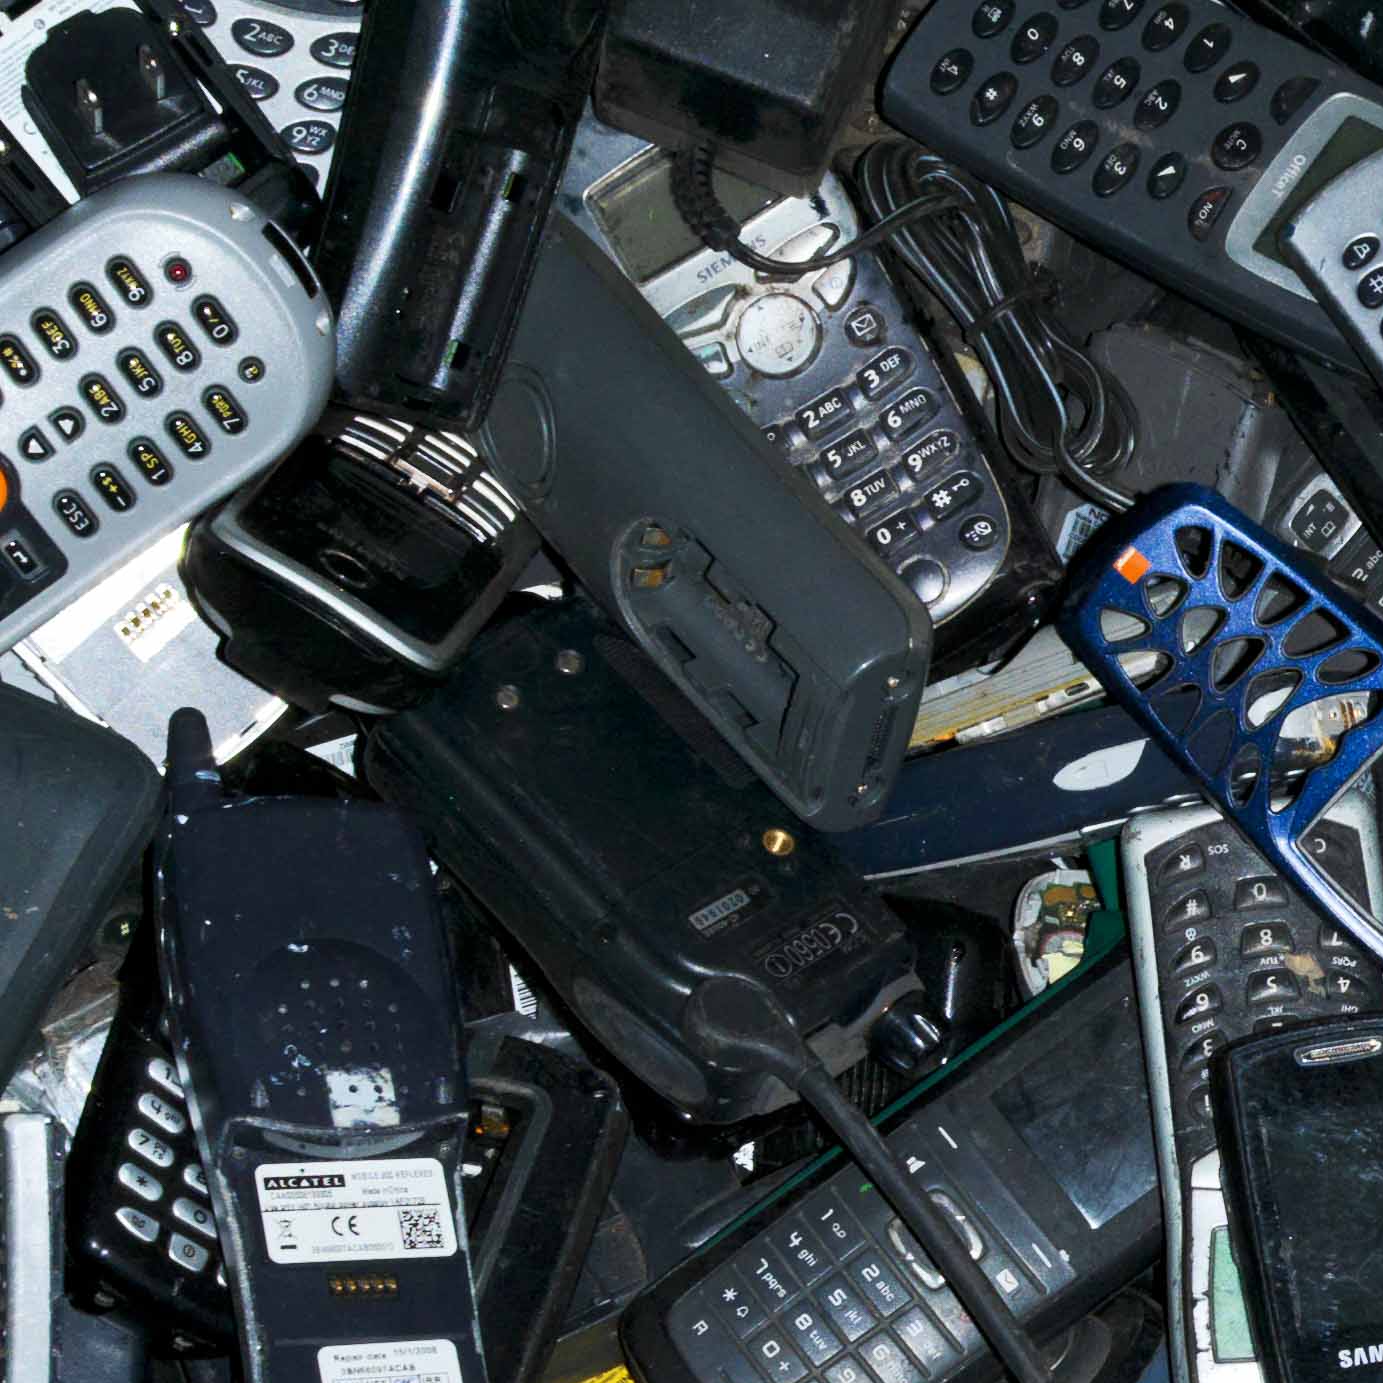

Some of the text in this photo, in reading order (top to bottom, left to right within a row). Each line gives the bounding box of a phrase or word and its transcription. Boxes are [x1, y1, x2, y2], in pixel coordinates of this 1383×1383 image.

[696, 235, 767, 284] SIEMS
[212, 324, 229, 338] 0
[63, 502, 90, 531] ESC
[265, 1177, 344, 1189] ALCATEL
